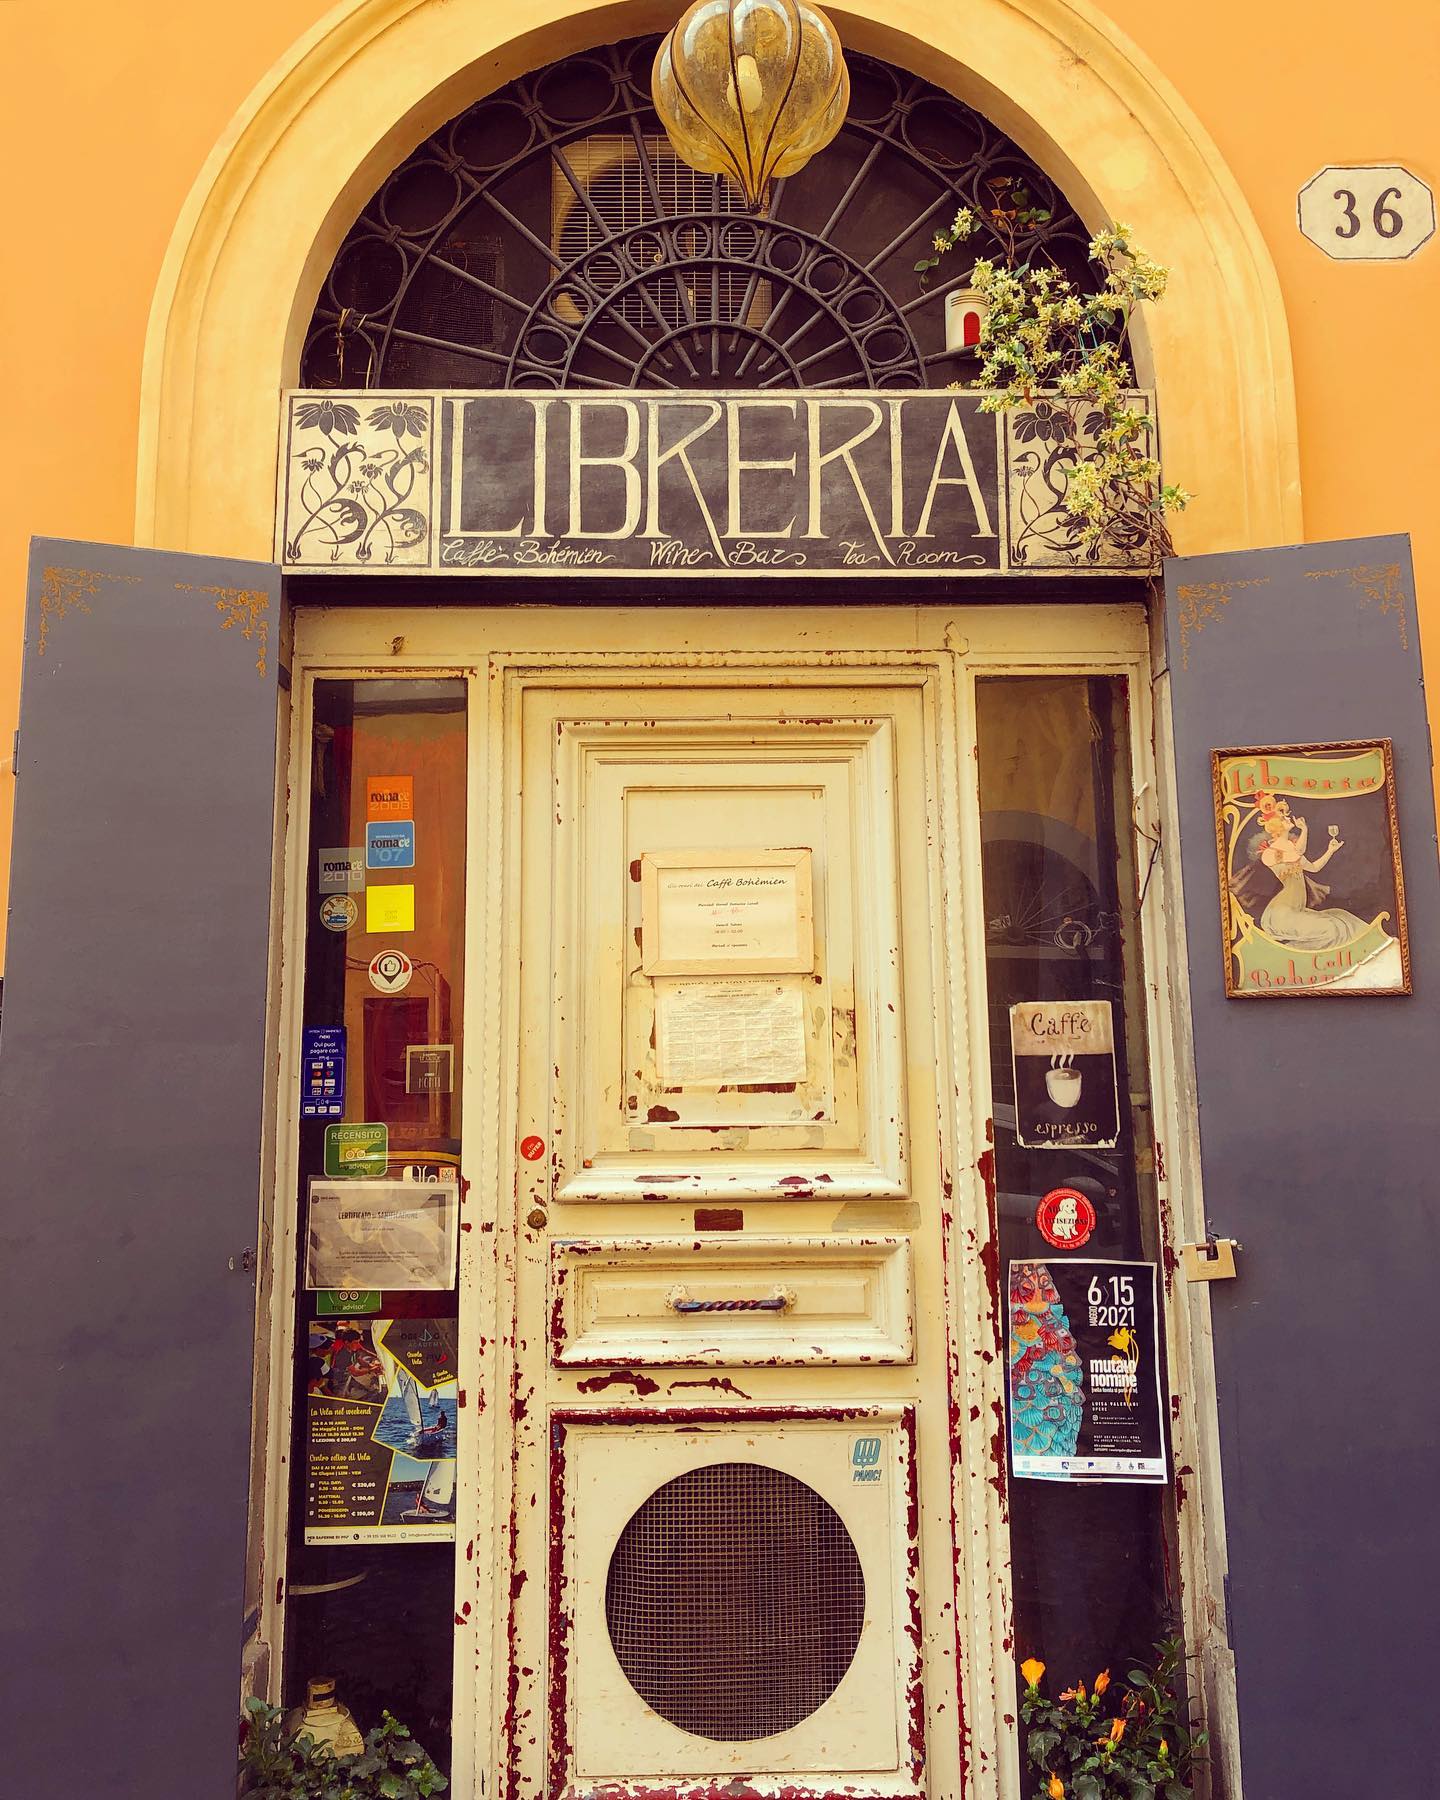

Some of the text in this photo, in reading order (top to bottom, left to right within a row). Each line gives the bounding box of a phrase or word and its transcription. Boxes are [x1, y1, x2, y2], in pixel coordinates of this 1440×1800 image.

[1334, 187, 1403, 239] 36
[442, 398, 998, 567] LIBRERIA
[442, 539, 510, 566] Caffè
[650, 540, 713, 566] Wine
[729, 541, 807, 565] Bar
[838, 541, 881, 564] Tea
[898, 541, 987, 566] Room
[323, 870, 363, 882] 2010
[706, 878, 733, 889] Caffè
[1030, 1012, 1092, 1036] Caffè
[331, 1130, 382, 1140] RECENSITO
[1034, 1123, 1098, 1138] espresso
[1098, 1306, 1135, 1327] 2021
[1090, 1373, 1138, 1388] nomine
[310, 1406, 372, 1416] La Vela nel weekend
[348, 1452, 356, 1461] di
[356, 1452, 371, 1461] Vela
[853, 1469, 882, 1482] PANIC!
